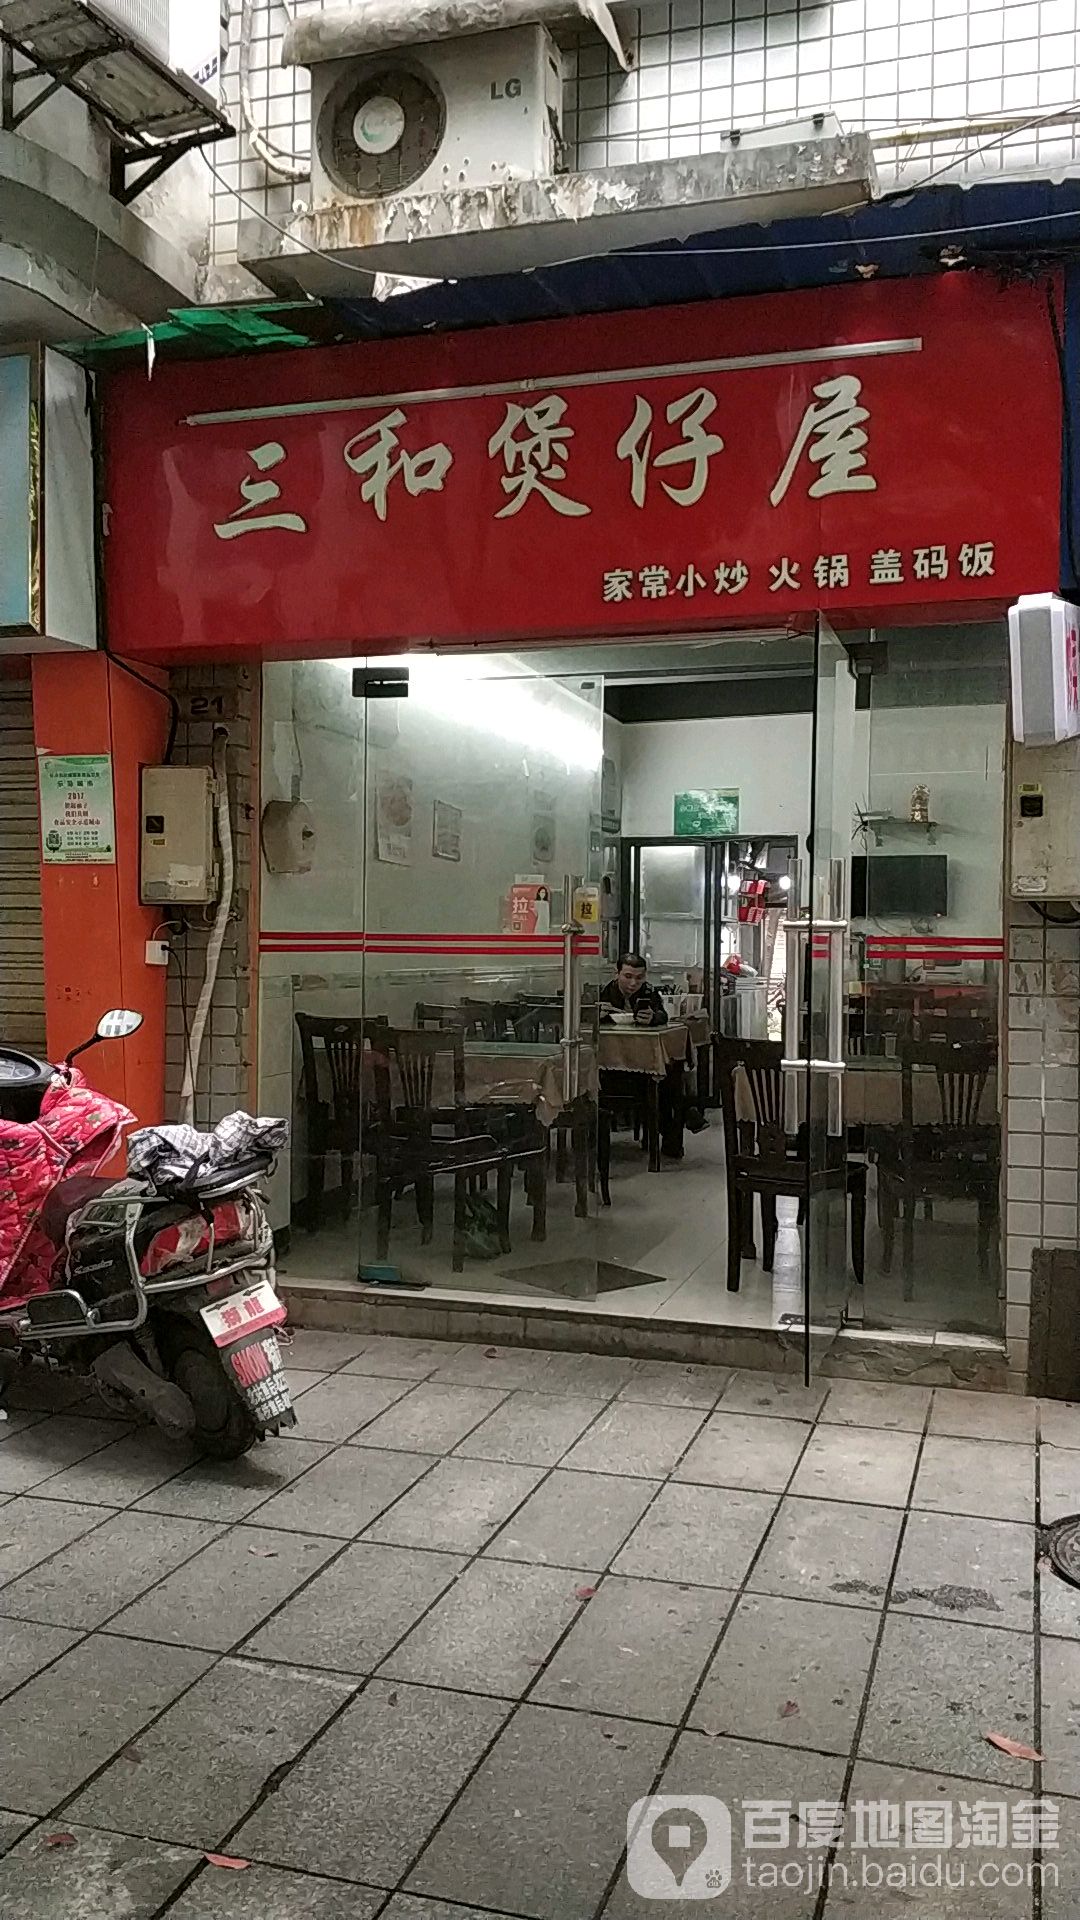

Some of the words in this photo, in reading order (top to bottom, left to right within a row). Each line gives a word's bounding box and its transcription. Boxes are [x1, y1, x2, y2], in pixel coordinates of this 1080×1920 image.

[490, 79, 522, 100] LG
[213, 375, 878, 540] 三和煲仔屋
[602, 560, 749, 603] 家常小炒
[768, 553, 851, 592] 火锅
[869, 541, 996, 586] 盖码饭
[190, 695, 223, 715] 21
[67, 792, 84, 800] 2017
[512, 897, 529, 914] 拉
[581, 902, 592, 914] 拉
